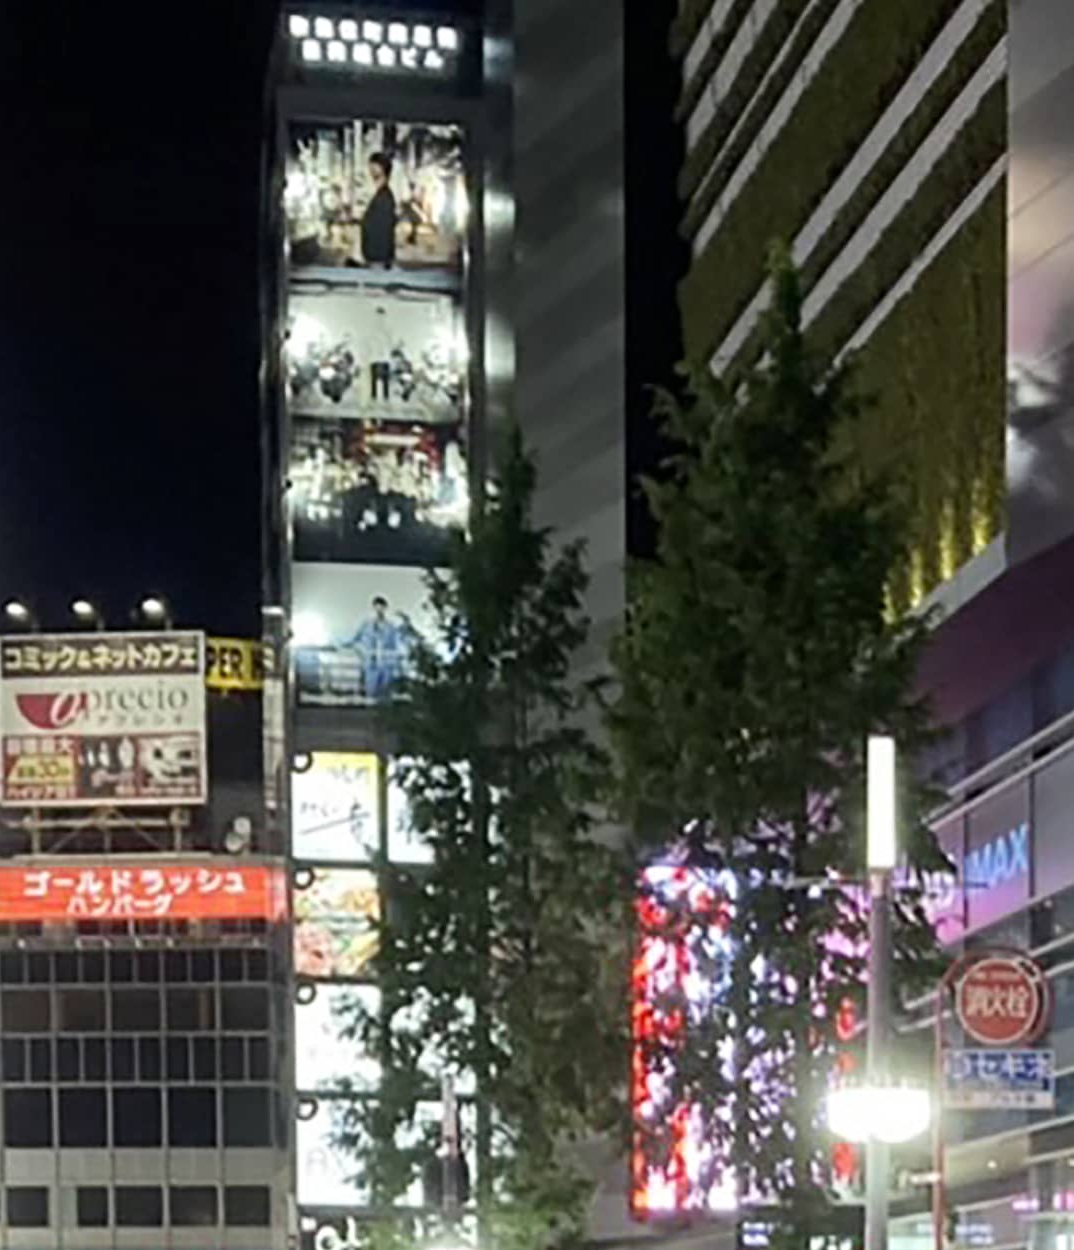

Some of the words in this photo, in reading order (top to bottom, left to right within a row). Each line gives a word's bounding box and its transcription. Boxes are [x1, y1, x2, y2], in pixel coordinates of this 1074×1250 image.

[3, 642, 197, 671] コミック&ネットカフェ
[23, 869, 246, 894] ゴールドラッシュ
[66, 893, 173, 916] ハンバーグ
